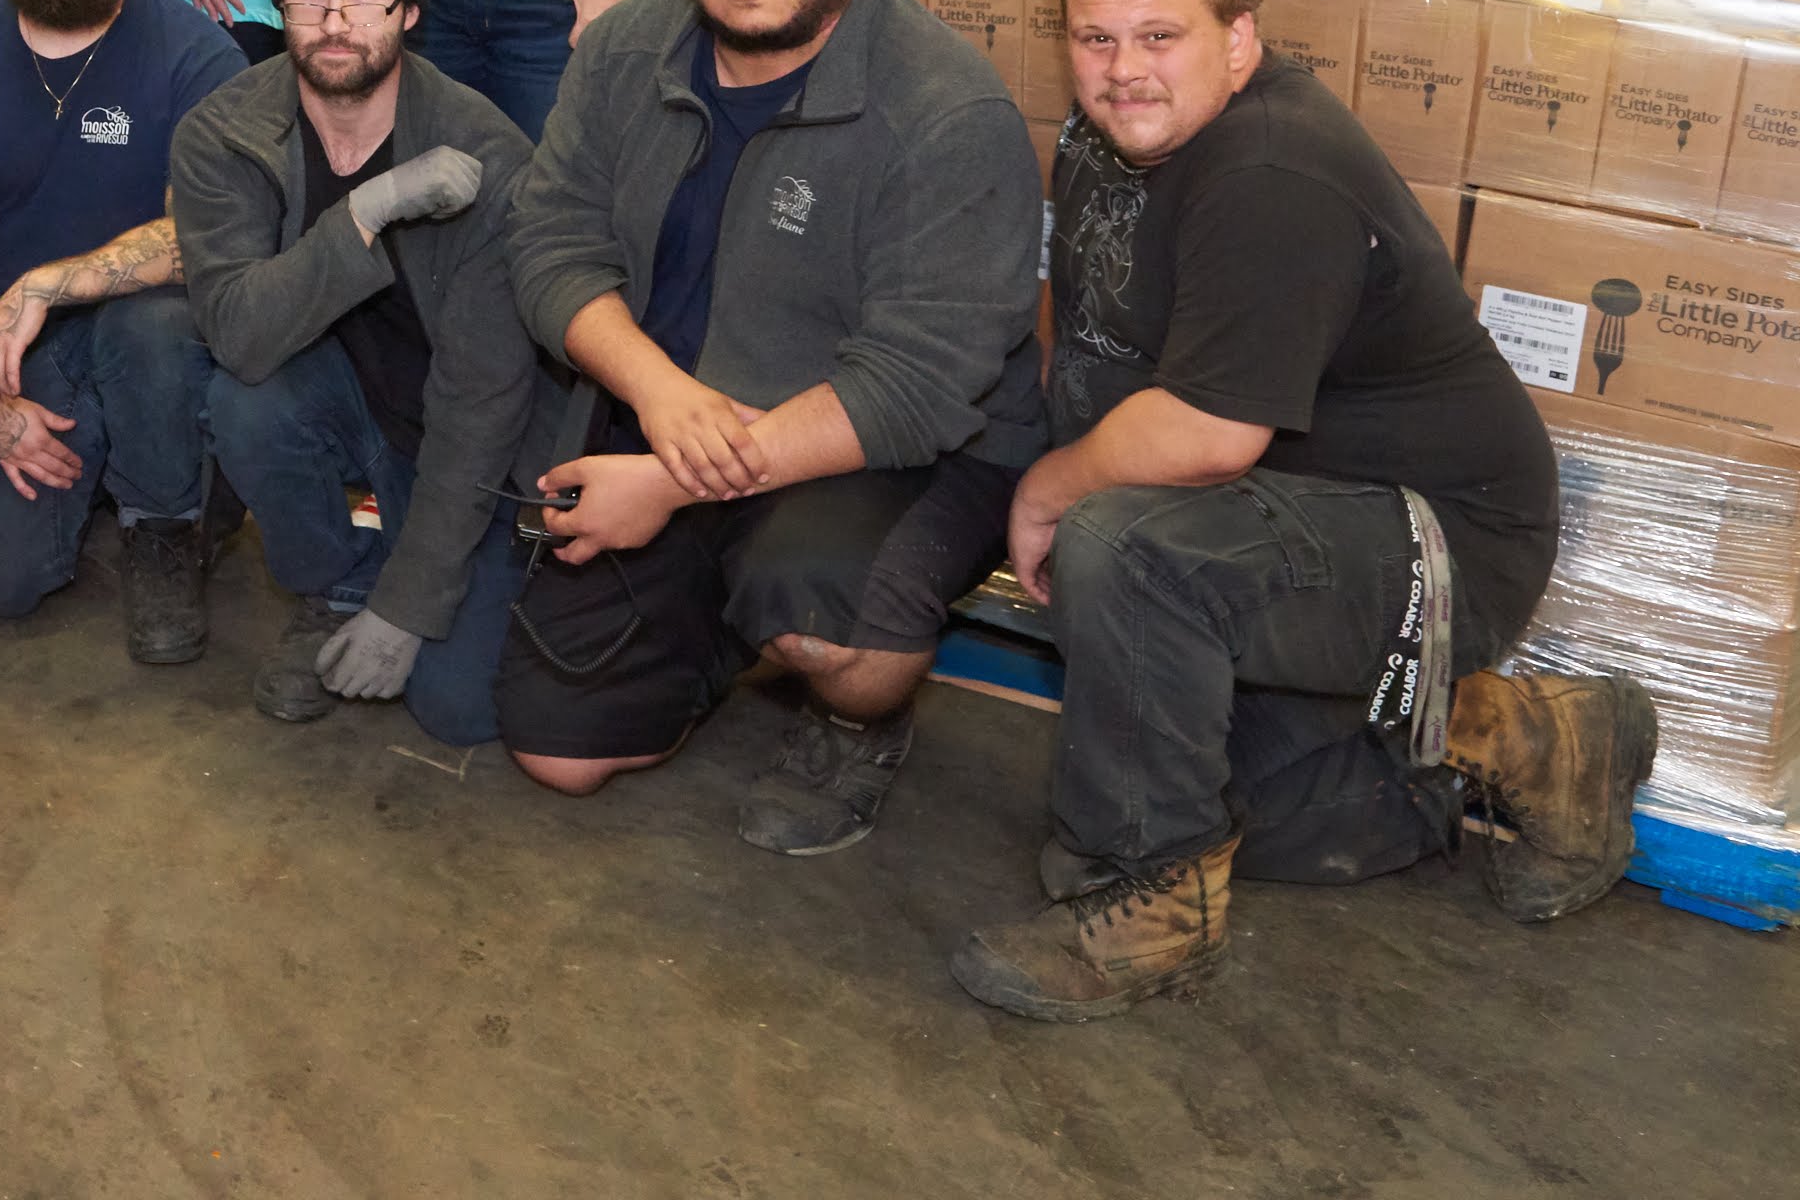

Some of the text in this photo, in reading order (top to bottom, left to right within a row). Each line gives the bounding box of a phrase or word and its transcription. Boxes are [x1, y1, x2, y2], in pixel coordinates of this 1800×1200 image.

[96, 134, 128, 145] RIVESUD
[1665, 275, 1785, 310] EASY SIDES
[1661, 294, 1739, 329] Little
[1656, 317, 1762, 353] Company
[1399, 580, 1422, 638] COLABOR
[1368, 671, 1395, 723] COLABOR
[1400, 658, 1419, 715] COLABOR
